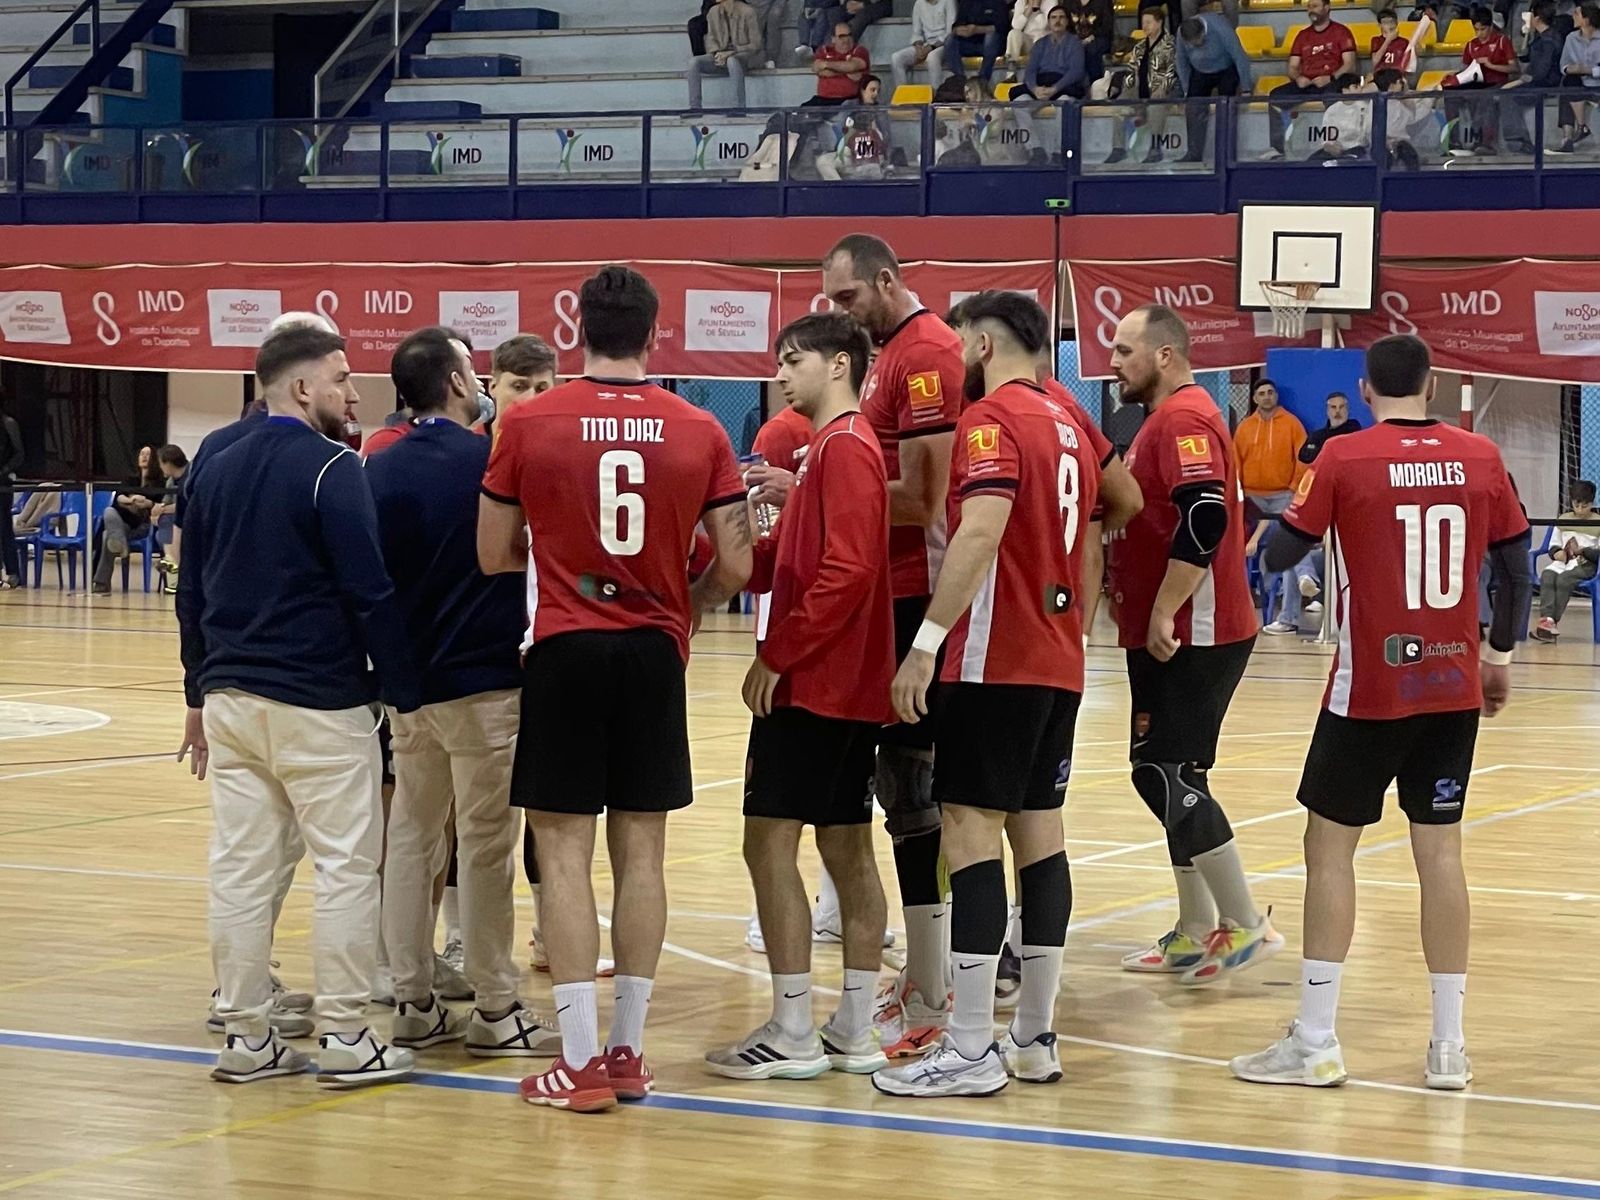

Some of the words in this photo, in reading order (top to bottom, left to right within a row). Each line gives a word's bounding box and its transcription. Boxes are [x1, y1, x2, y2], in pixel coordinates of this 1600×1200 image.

[1384, 52, 1395, 63] 21
[1001, 129, 1030, 144] IMD
[1151, 134, 1181, 149] IMD
[1308, 126, 1339, 142] IMD
[452, 148, 482, 164] IMD
[584, 145, 613, 161] IMD
[719, 142, 749, 159] IMD
[84, 155, 111, 171] IMD
[138, 290, 185, 312] IMD
[365, 290, 413, 314] IMD
[1154, 284, 1214, 308] IMD
[1441, 290, 1502, 316] IMD
[580, 417, 618, 442] TITO
[623, 418, 665, 442] DIAZ
[1389, 462, 1466, 487] MORALES
[599, 449, 646, 556] 6
[1057, 452, 1080, 556] 8
[1395, 504, 1467, 610] 10
